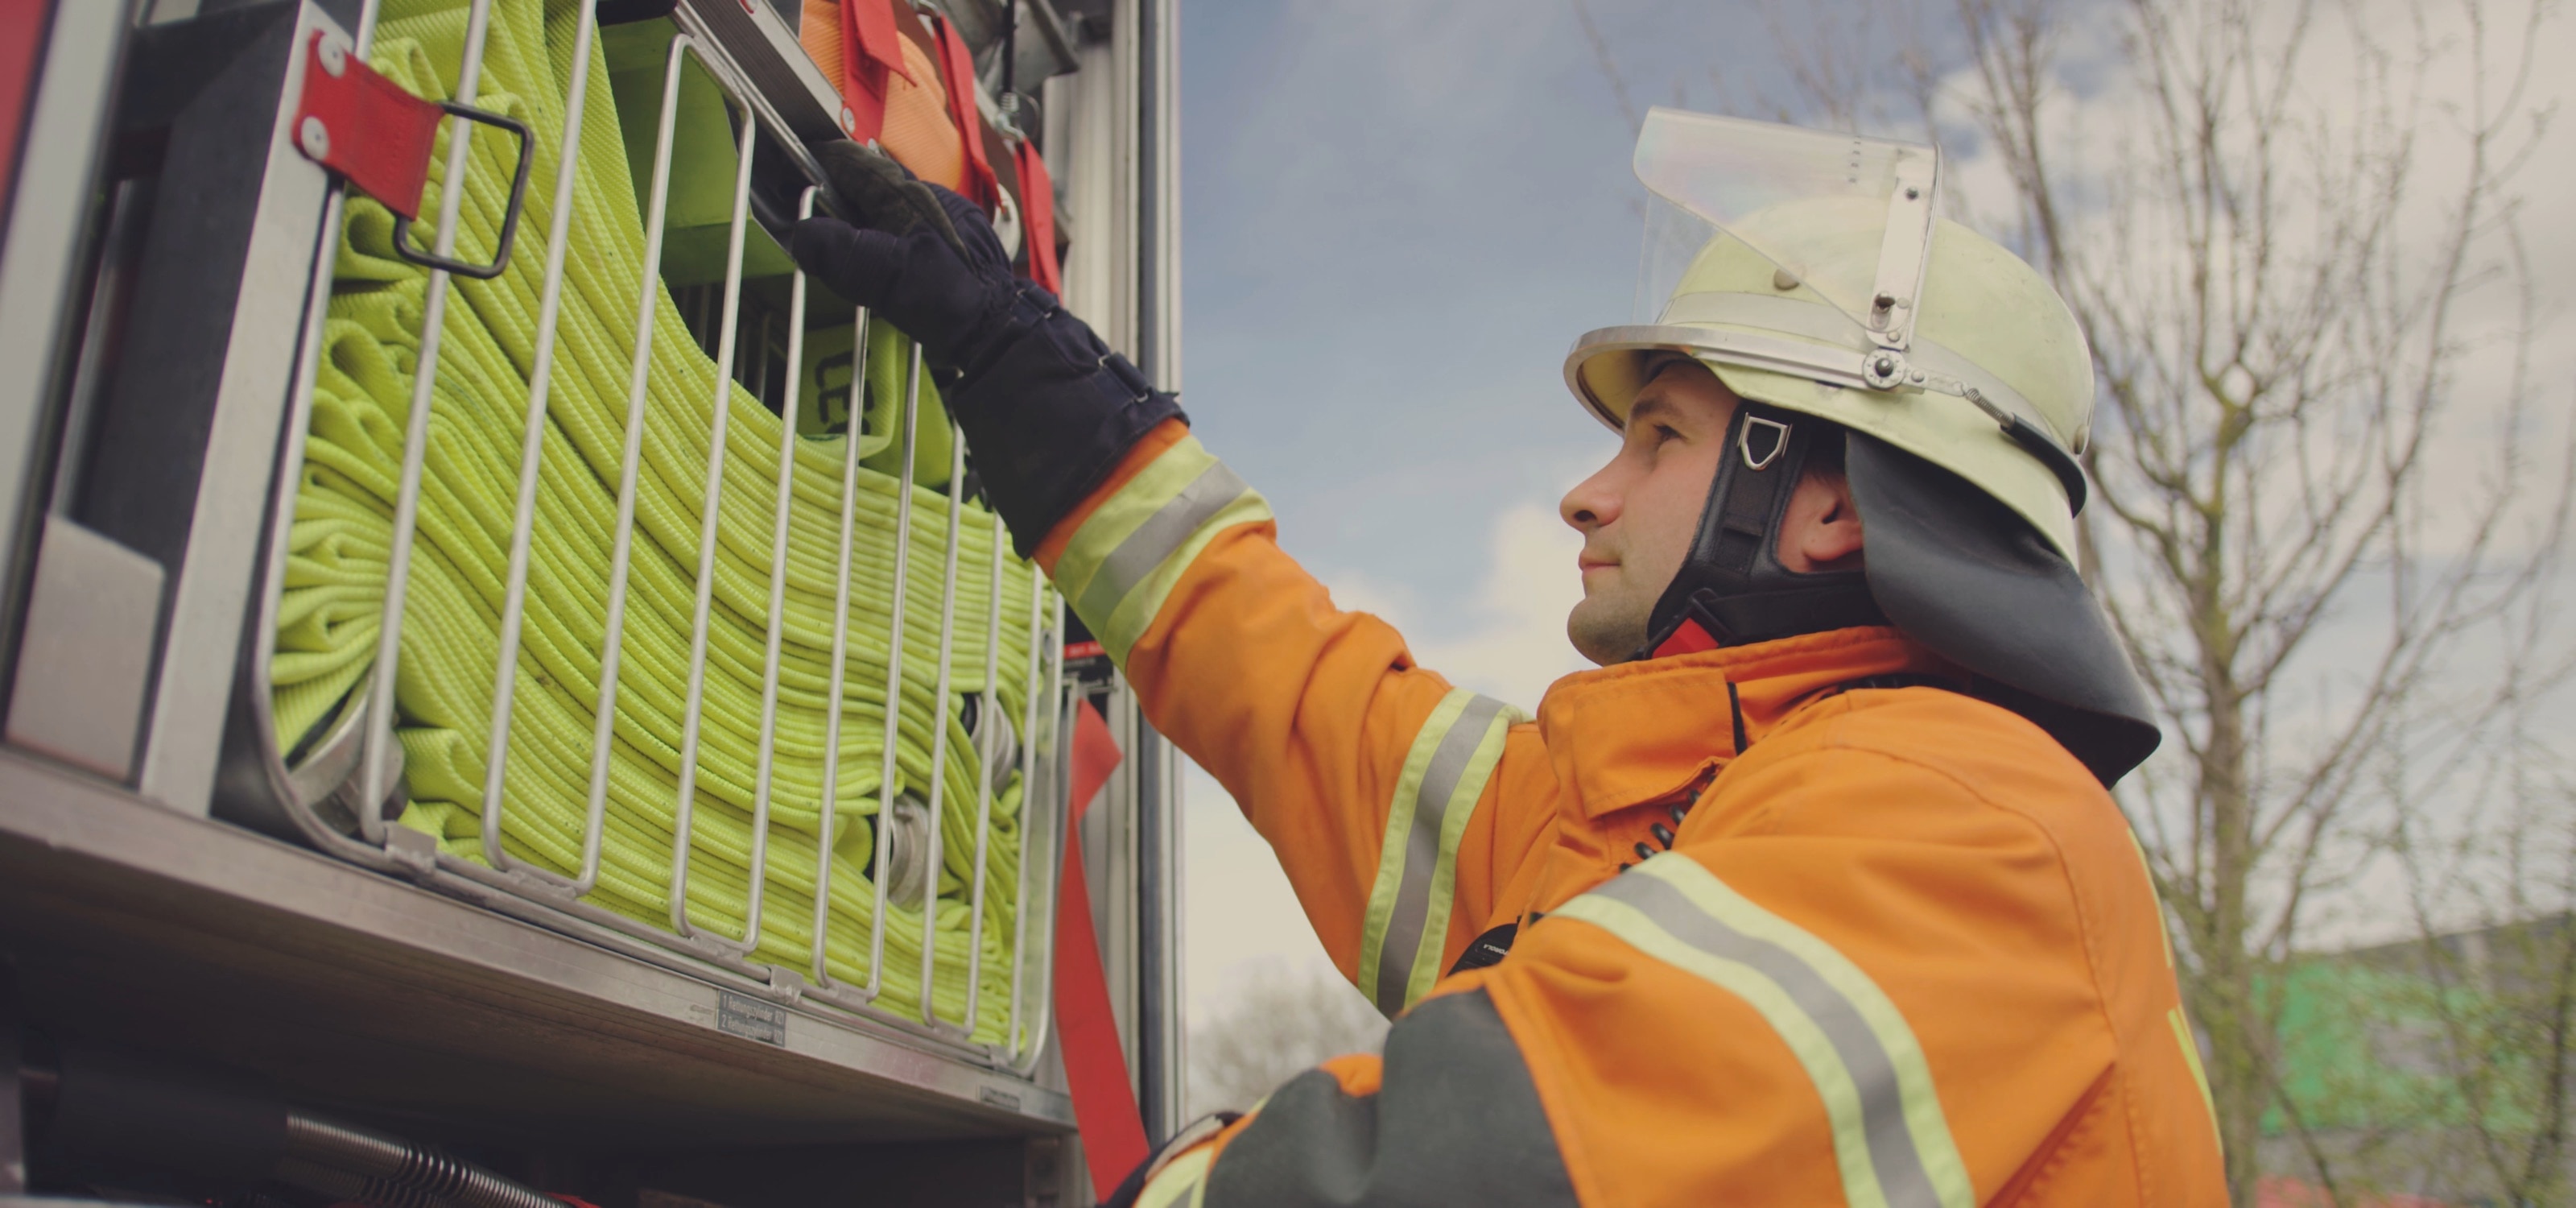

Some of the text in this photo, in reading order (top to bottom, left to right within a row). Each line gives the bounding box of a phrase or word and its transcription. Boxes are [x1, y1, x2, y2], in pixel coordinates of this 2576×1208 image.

[1483, 943, 1509, 955] TOROLA
[723, 995, 727, 1008] 1
[728, 995, 773, 1022] Rettungszylinder
[721, 1013, 727, 1028] 2
[727, 1016, 772, 1040] Rettungszylinder
